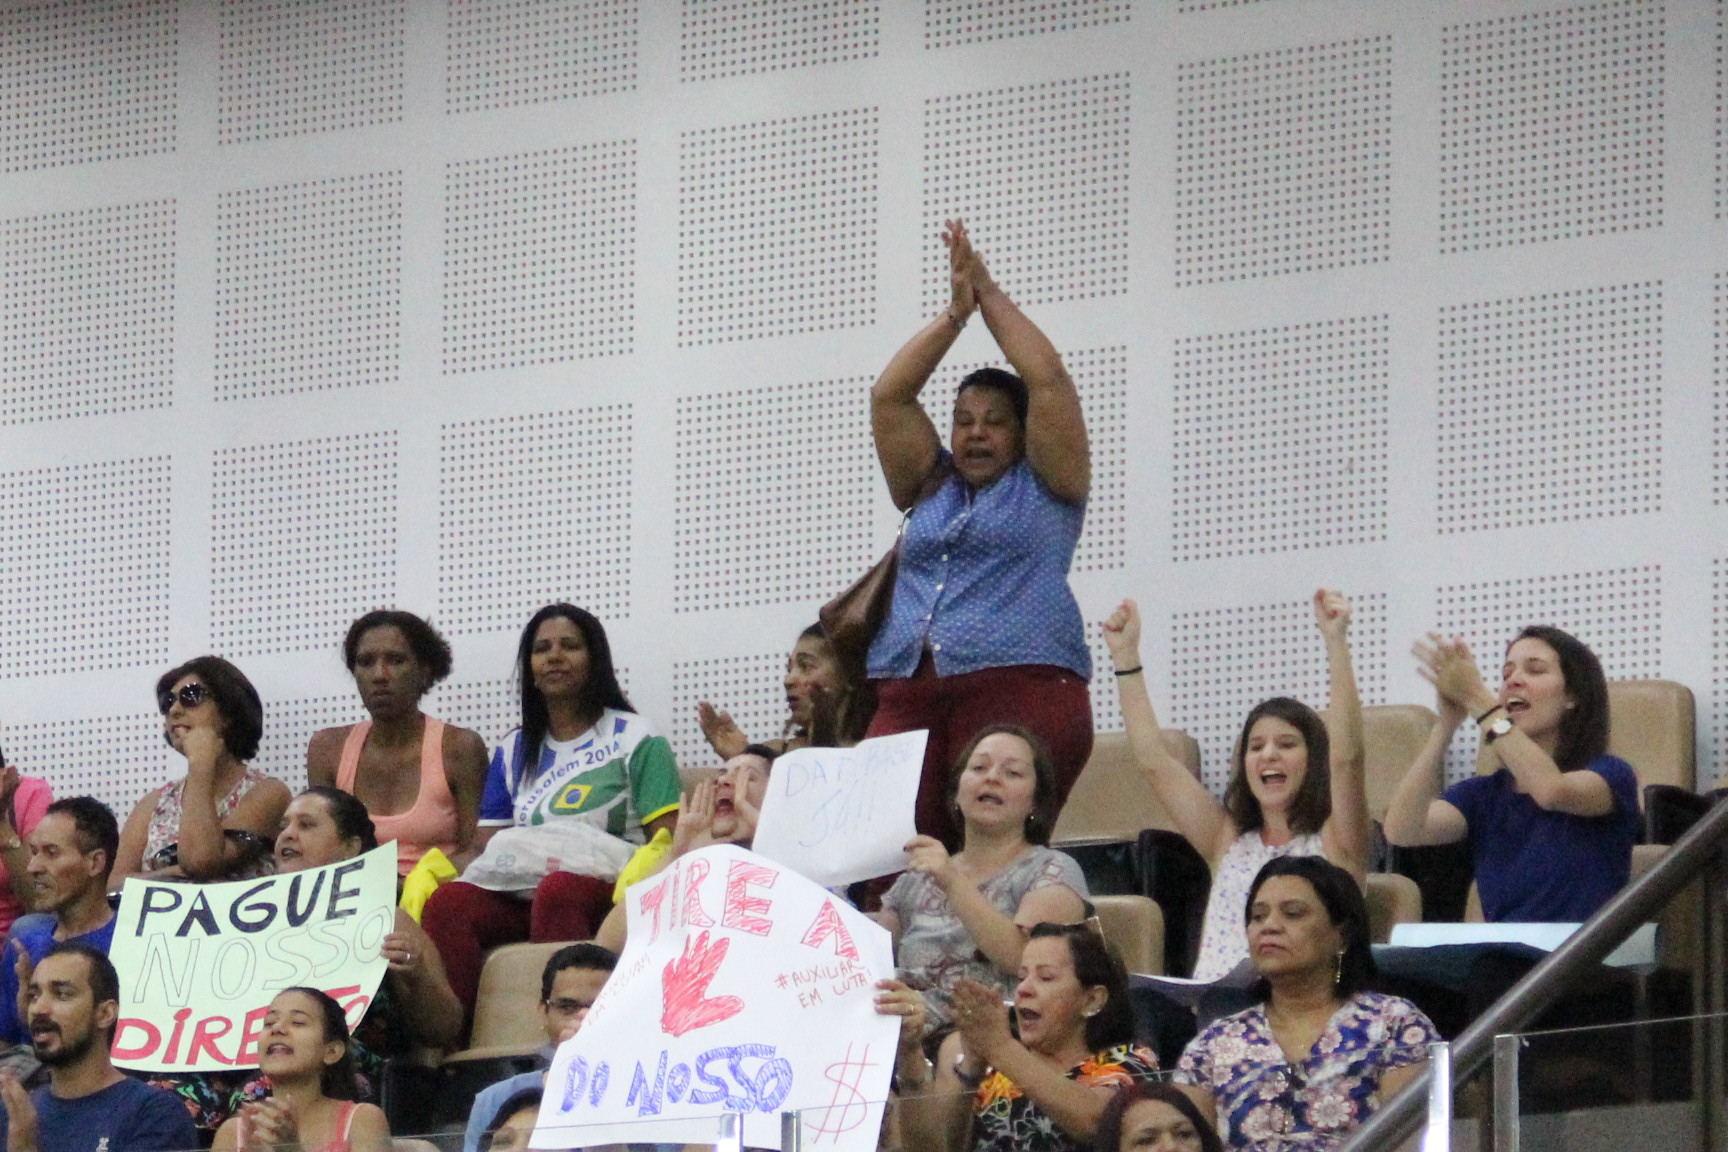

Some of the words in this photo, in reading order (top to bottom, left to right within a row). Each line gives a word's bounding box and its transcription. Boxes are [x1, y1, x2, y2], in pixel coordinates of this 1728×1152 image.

[584, 740, 620, 766] 2014
[135, 858, 365, 937] PAGUE
[640, 857, 780, 945] TIRE
[801, 897, 860, 962] A
[133, 905, 393, 1007] NOSSO
[110, 984, 370, 1066] DIREO
[798, 987, 824, 1009] EM
[556, 1054, 610, 1116] DO
[626, 1043, 793, 1118] NOSSO
